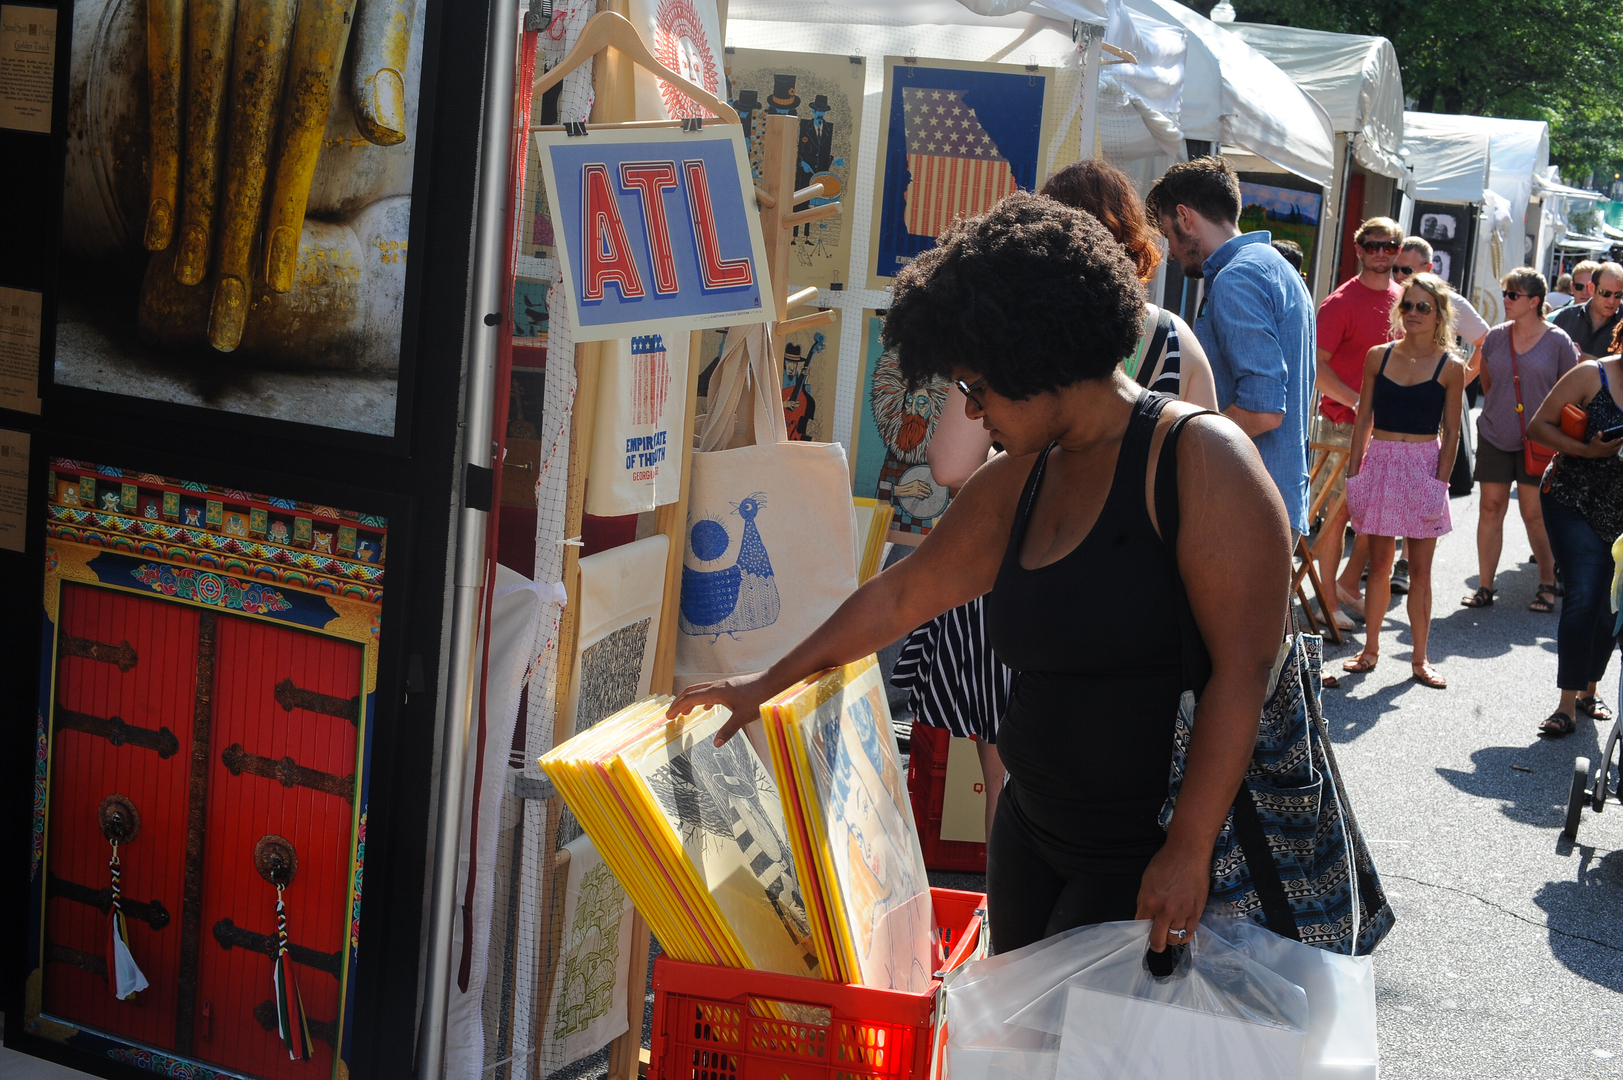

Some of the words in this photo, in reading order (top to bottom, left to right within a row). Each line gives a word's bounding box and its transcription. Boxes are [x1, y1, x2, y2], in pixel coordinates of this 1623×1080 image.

[580, 159, 754, 303] ATL
[625, 454, 636, 470] OF
[973, 782, 986, 794] Q
